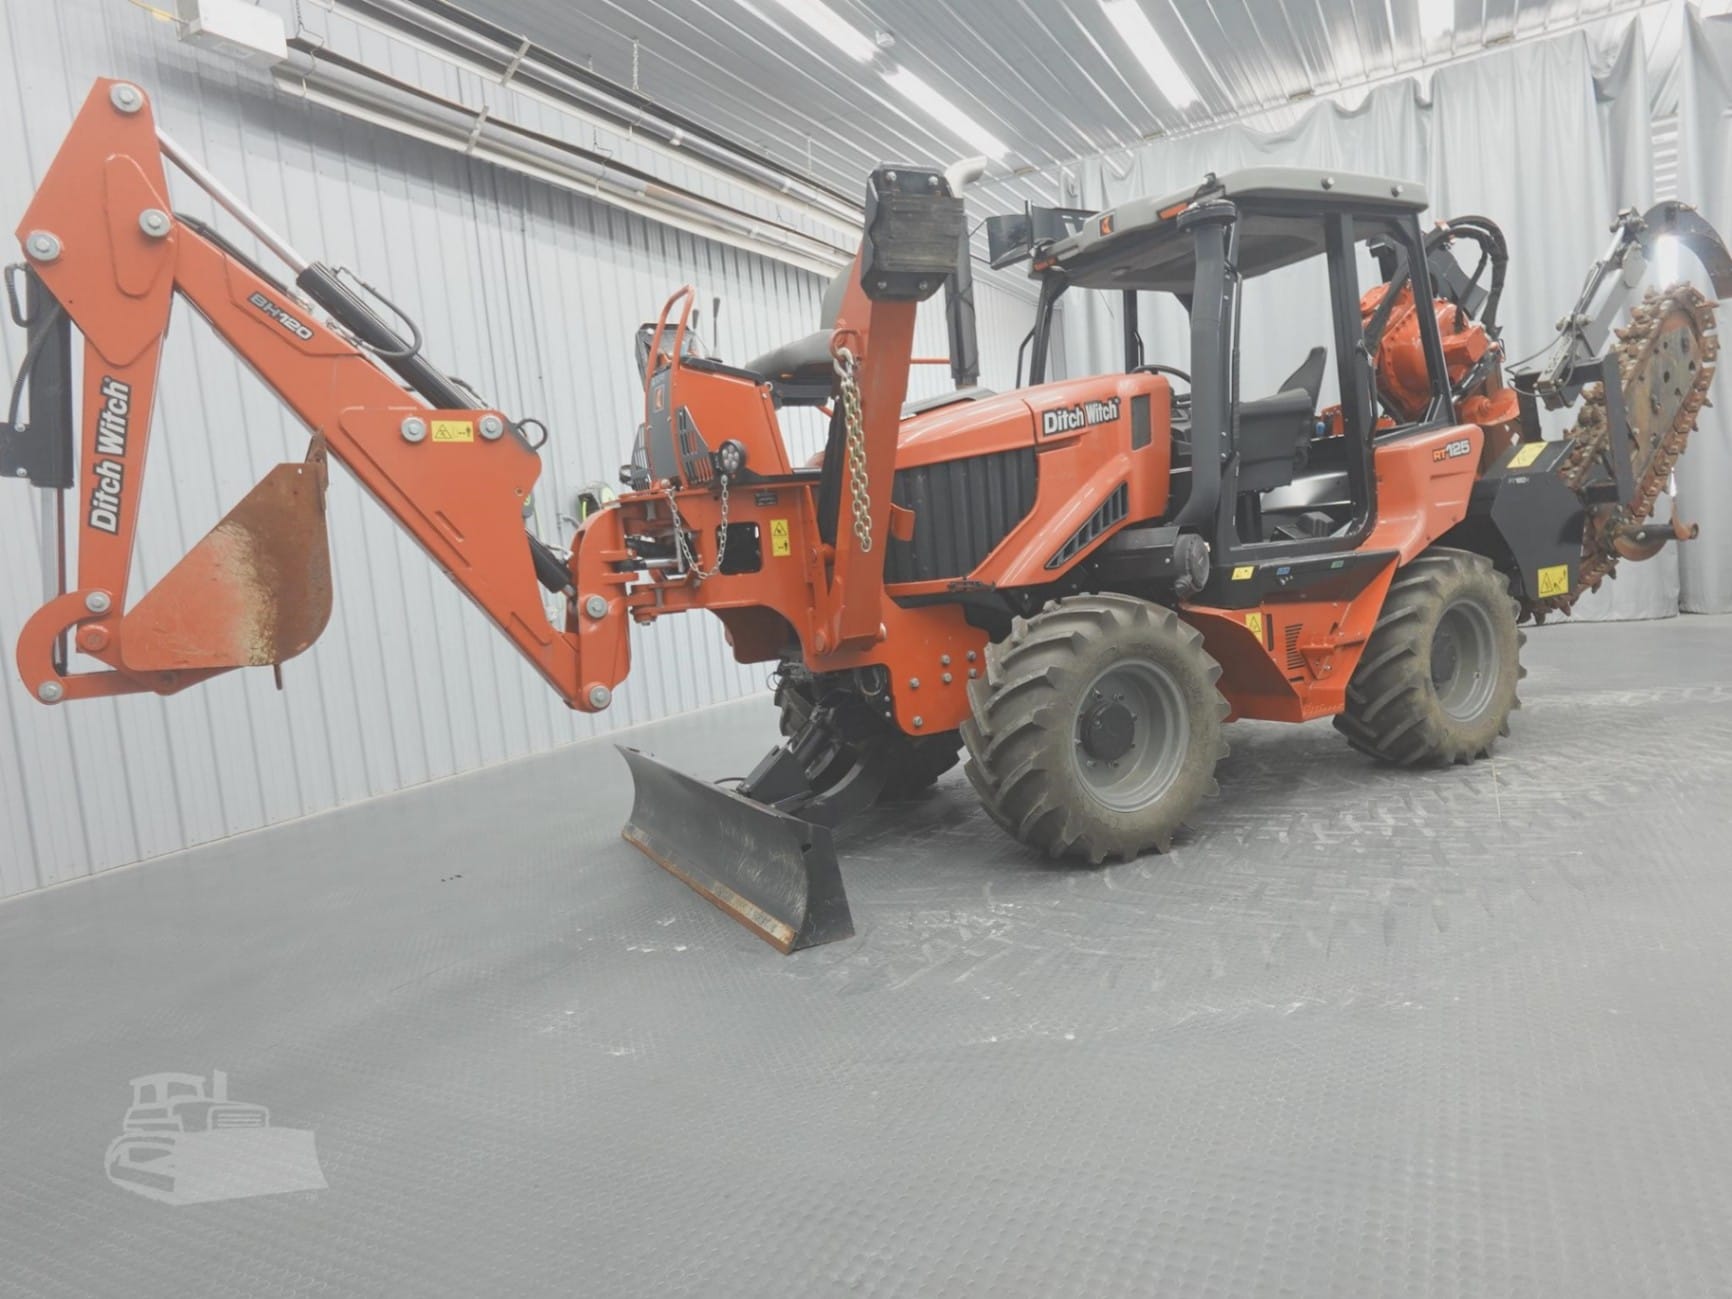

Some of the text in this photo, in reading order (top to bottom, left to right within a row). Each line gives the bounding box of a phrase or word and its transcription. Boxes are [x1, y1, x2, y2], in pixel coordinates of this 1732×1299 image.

[249, 292, 313, 340] BH120
[1043, 399, 1118, 435] Ditch Witch
[90, 379, 130, 534] Ditch Witch
